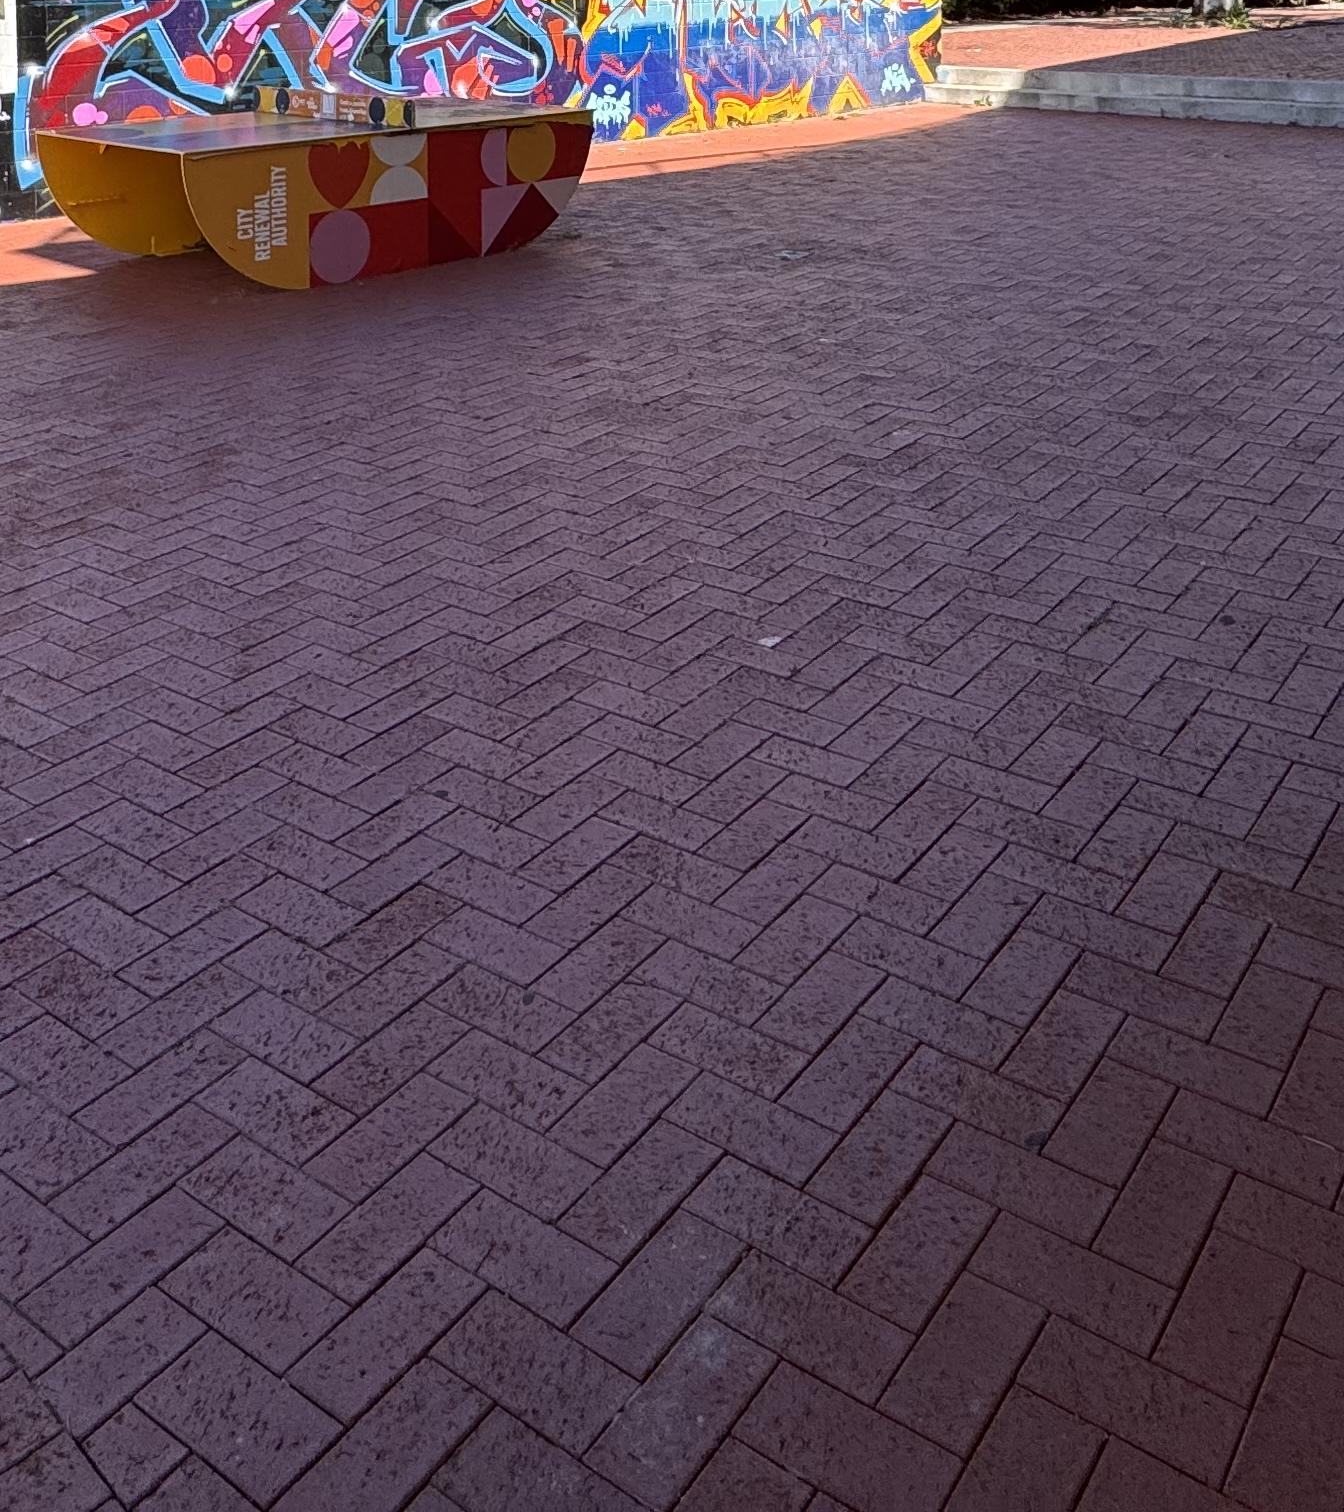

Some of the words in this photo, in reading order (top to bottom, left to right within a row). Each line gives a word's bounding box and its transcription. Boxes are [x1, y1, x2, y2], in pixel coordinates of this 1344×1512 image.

[236, 208, 254, 240] CITY
[254, 190, 271, 261] RENEWAL
[270, 165, 287, 247] AUTHORITY
